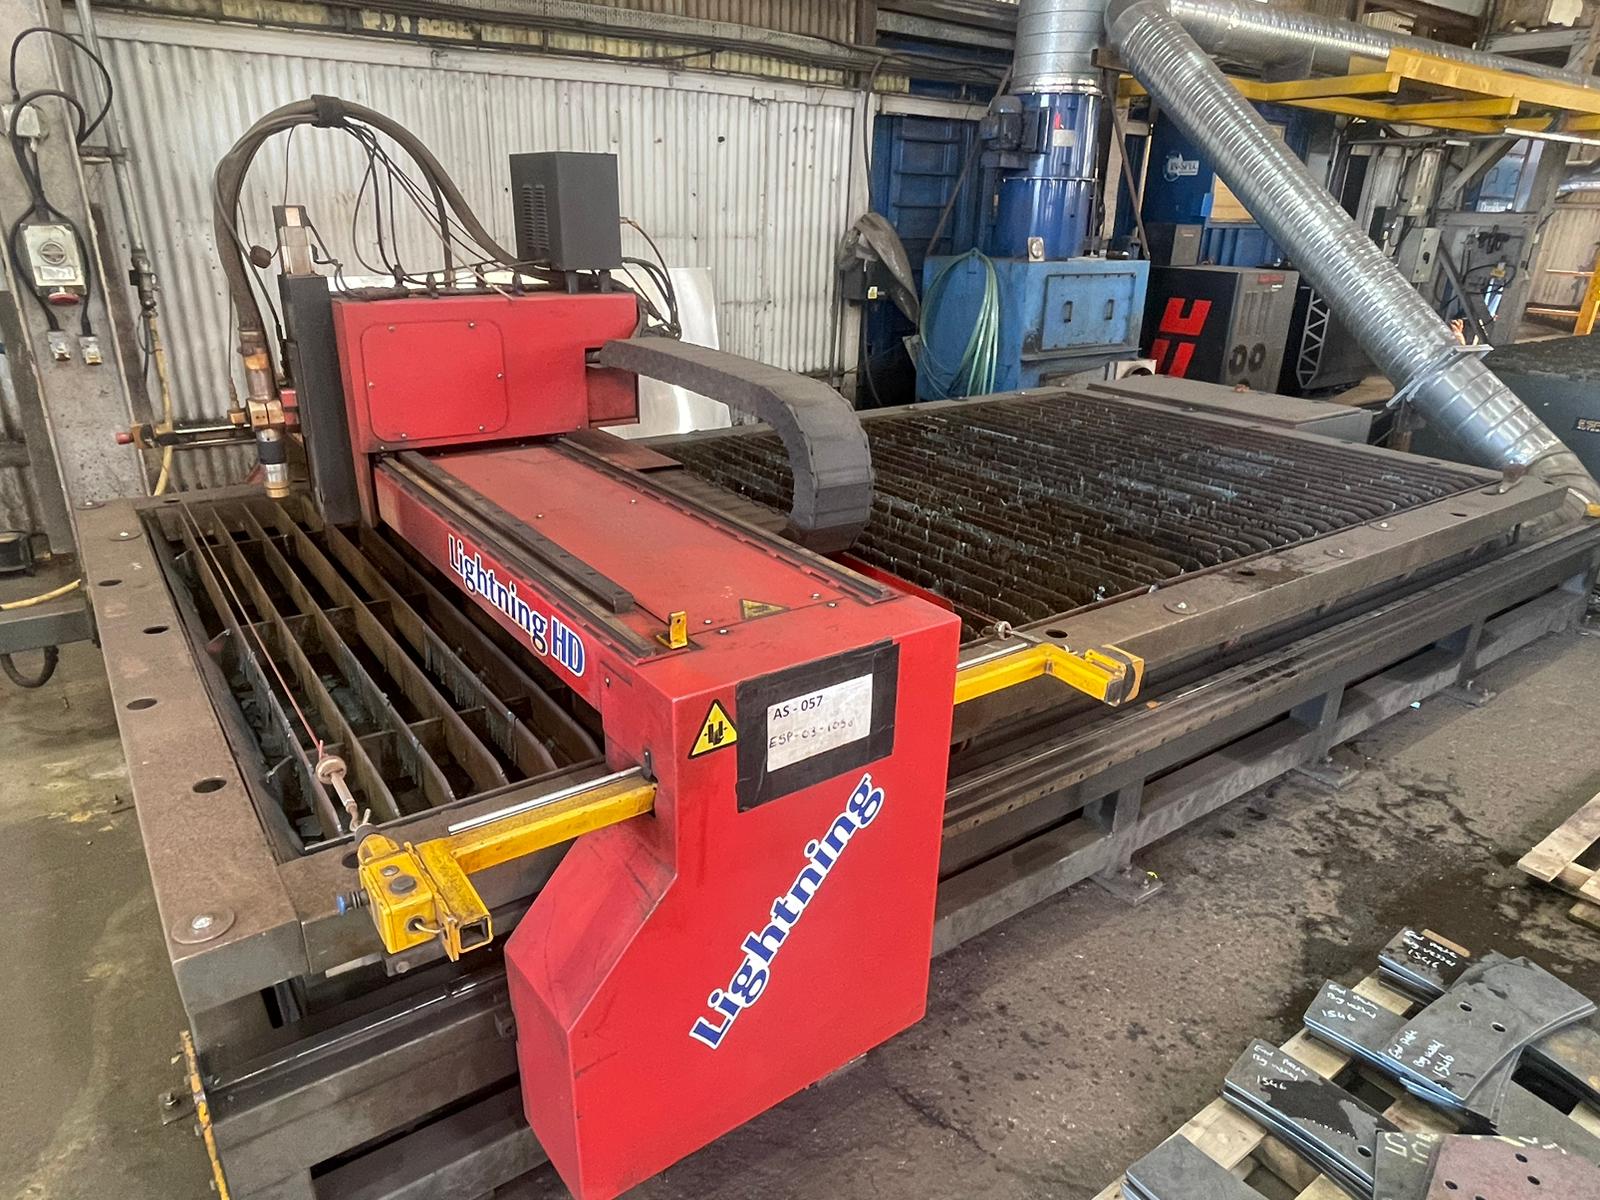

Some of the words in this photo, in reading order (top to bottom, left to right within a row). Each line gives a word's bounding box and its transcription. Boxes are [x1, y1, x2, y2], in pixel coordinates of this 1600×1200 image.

[448, 534, 548, 657] Lightning
[551, 615, 586, 677] HD
[689, 773, 884, 1049] Lightning
